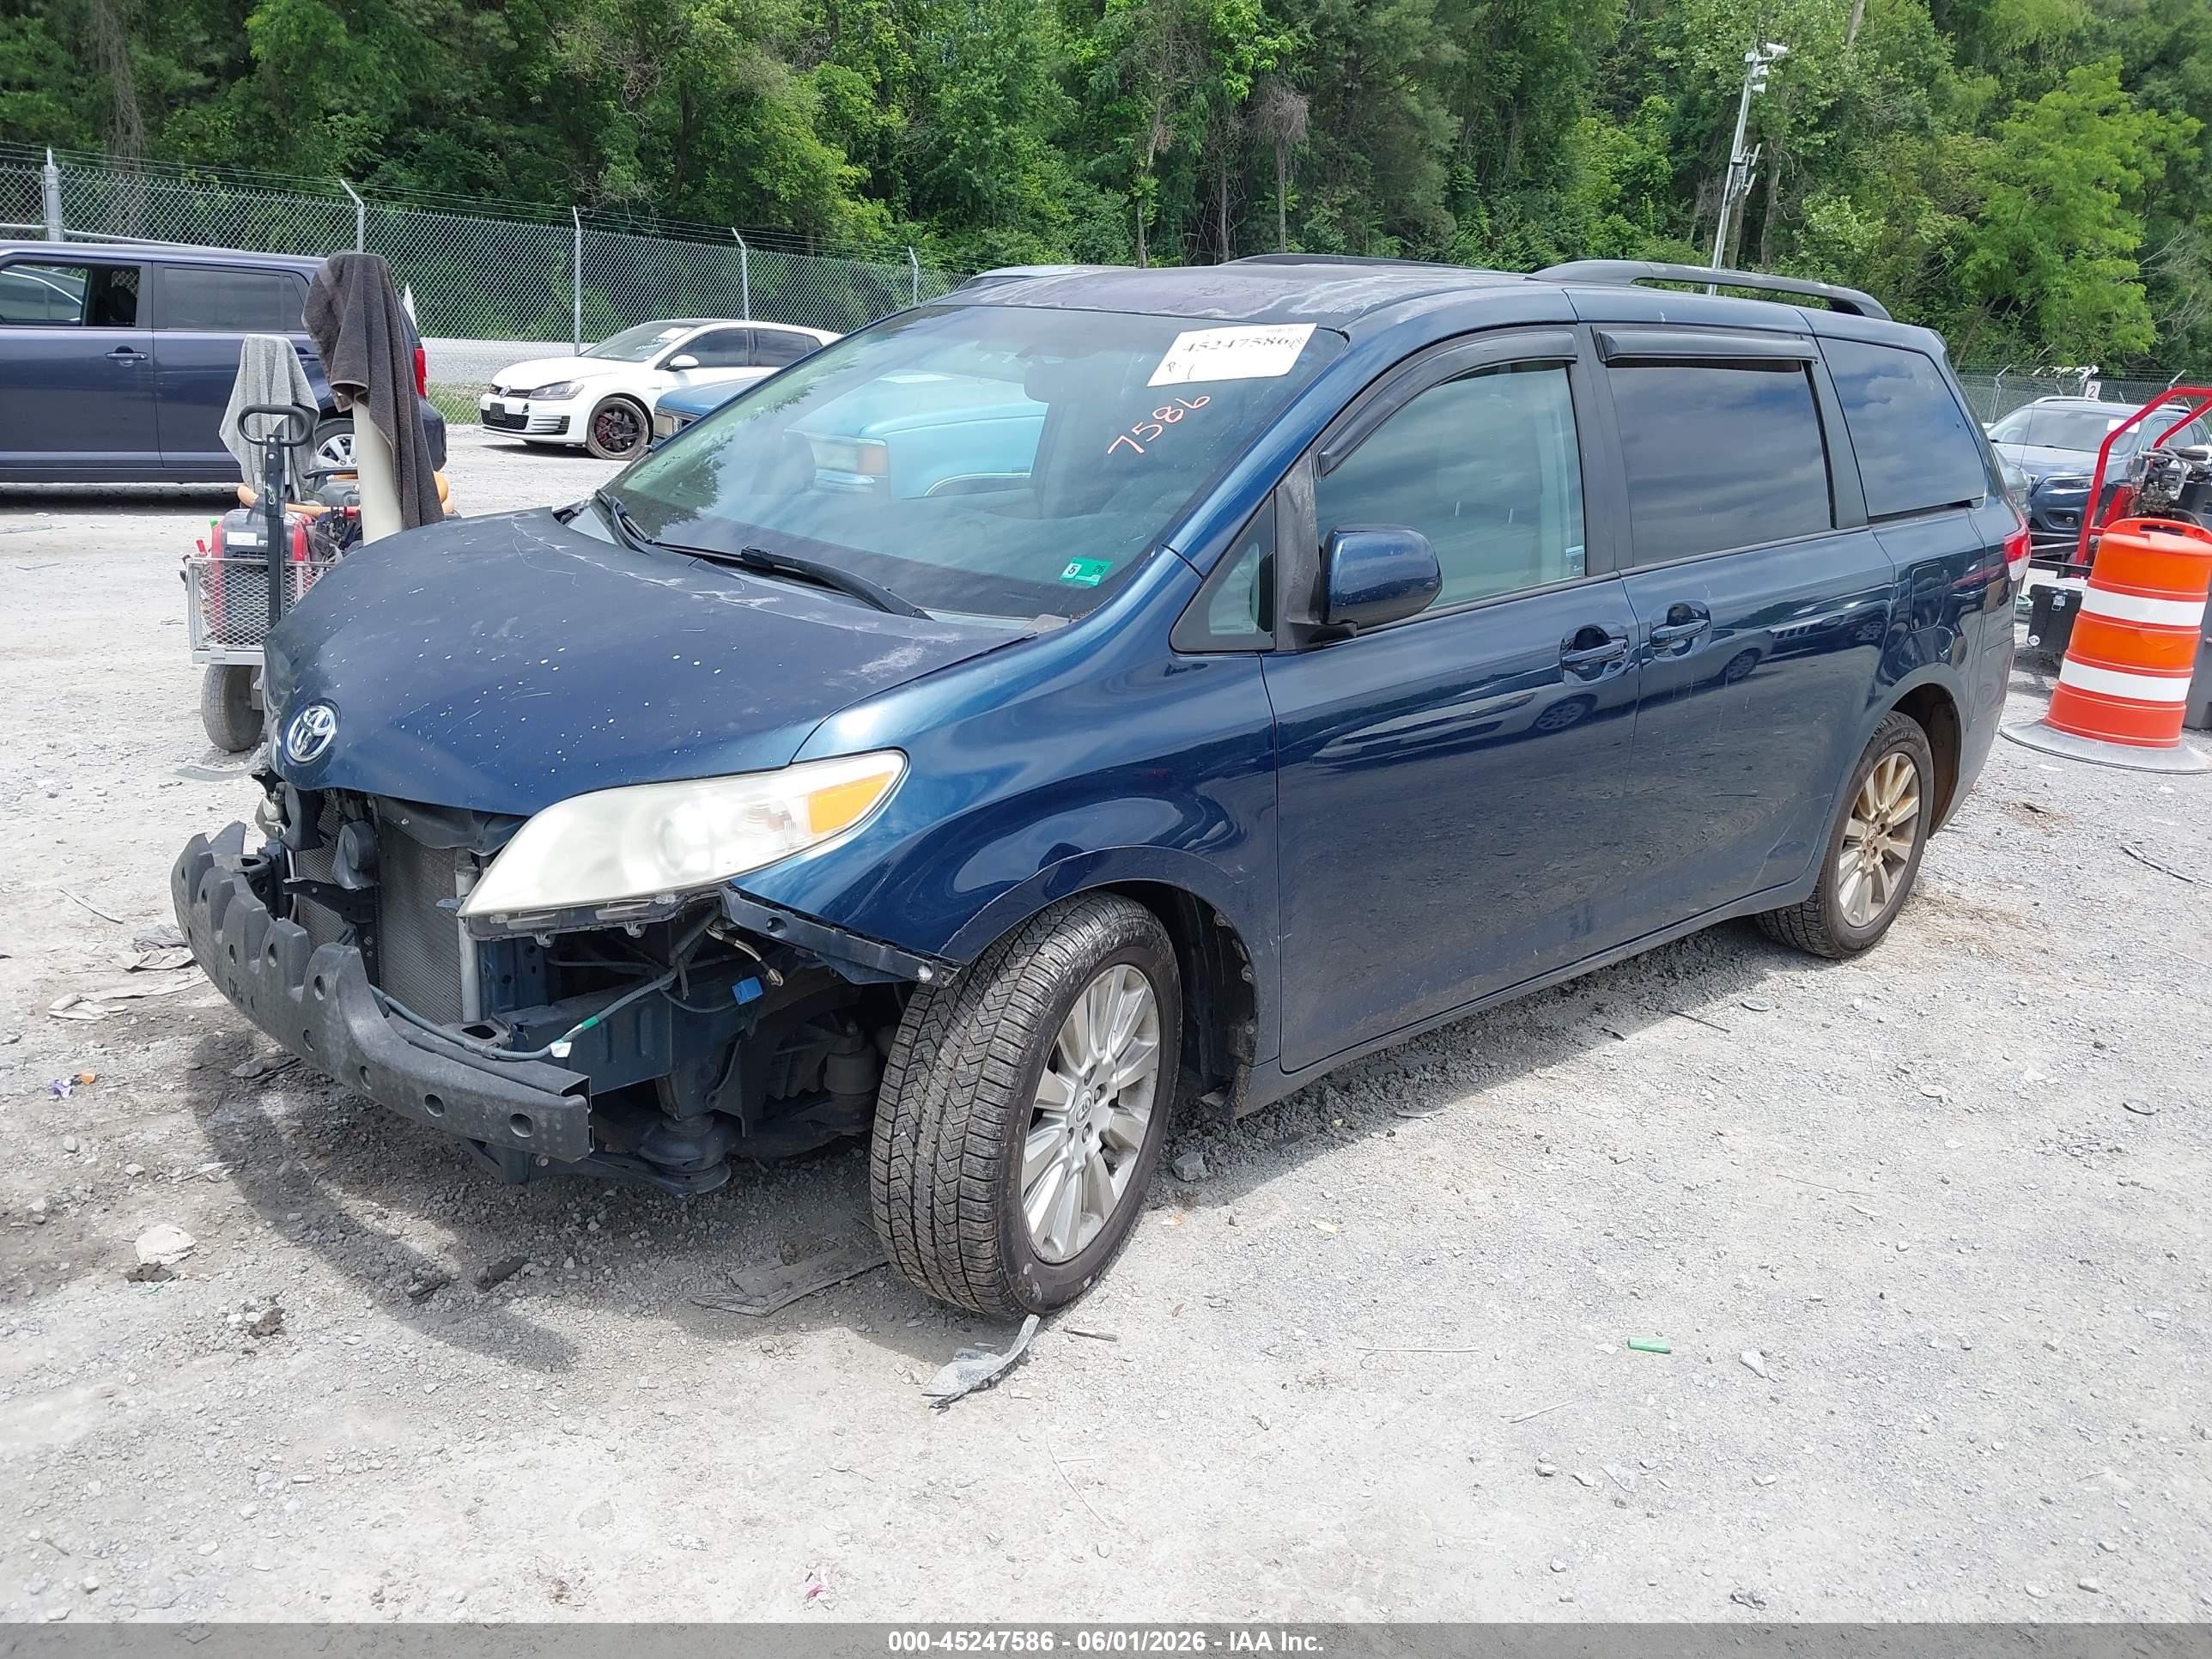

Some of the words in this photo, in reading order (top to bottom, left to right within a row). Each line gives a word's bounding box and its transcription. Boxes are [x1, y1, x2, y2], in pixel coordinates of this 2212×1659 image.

[2087, 385, 2096, 398] 2
[1107, 396, 1211, 454] 7586
[1067, 564, 1079, 574] 5
